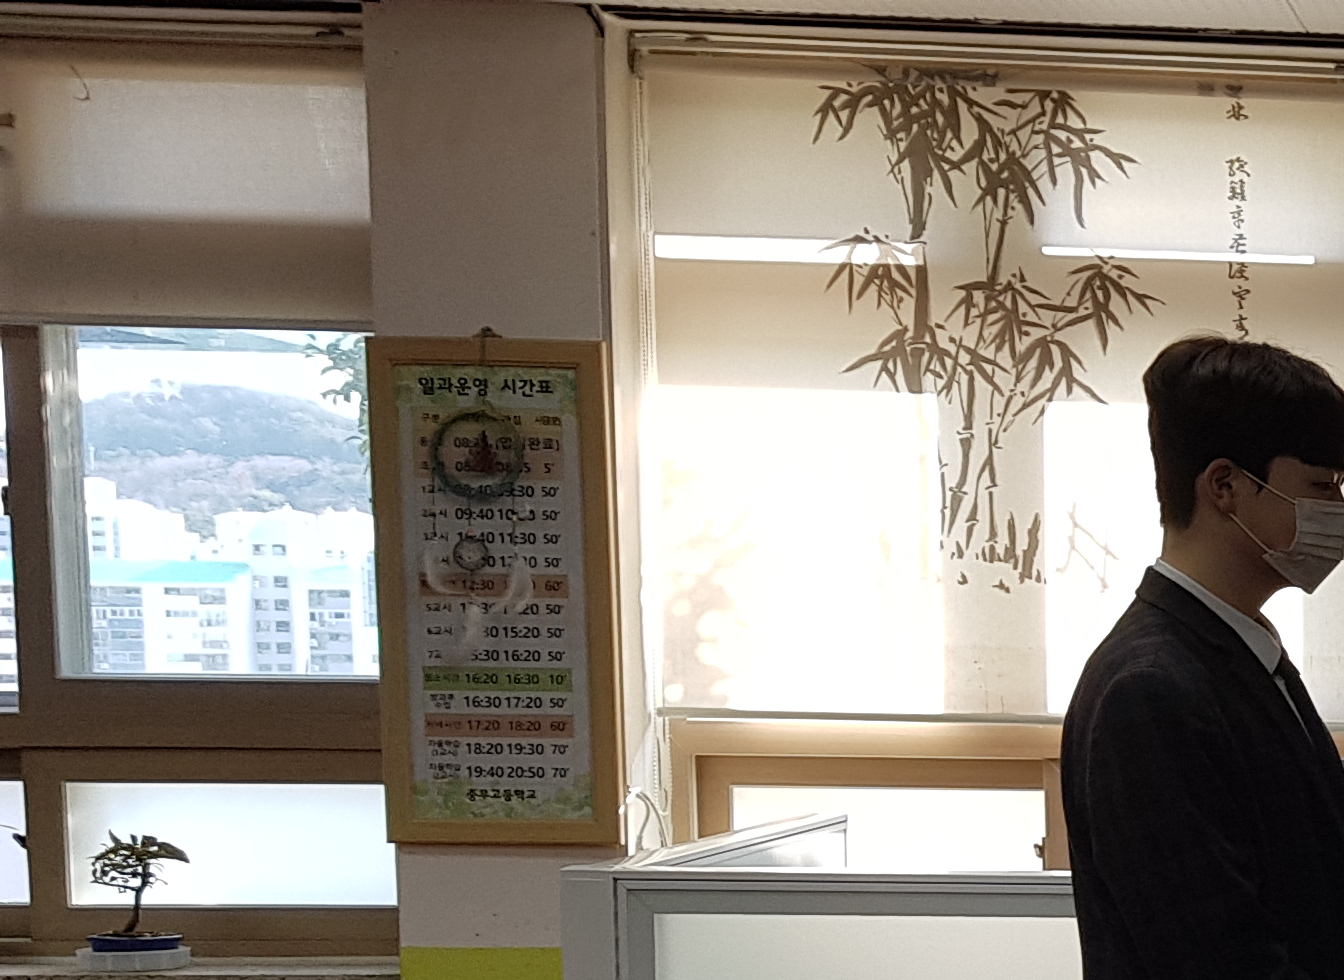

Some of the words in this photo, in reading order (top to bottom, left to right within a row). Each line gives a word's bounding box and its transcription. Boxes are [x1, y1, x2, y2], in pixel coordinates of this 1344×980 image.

[418, 377, 489, 397] 일과운영
[500, 378, 554, 397] 시간표
[455, 508, 494, 520] 09:40
[498, 532, 537, 545] 11:30
[502, 627, 541, 638] 15:20
[504, 651, 541, 662] 16:20
[465, 673, 498, 684] 16:20
[506, 674, 540, 685] 16:30
[463, 696, 501, 708] 16:30
[504, 697, 543, 708] 17:20
[467, 720, 500, 731] 17:20
[508, 721, 541, 731] 18:20
[465, 743, 504, 755] 18:20
[507, 743, 545, 755] 19:30
[466, 766, 504, 778] 19:40
[507, 766, 545, 778] 20:50
